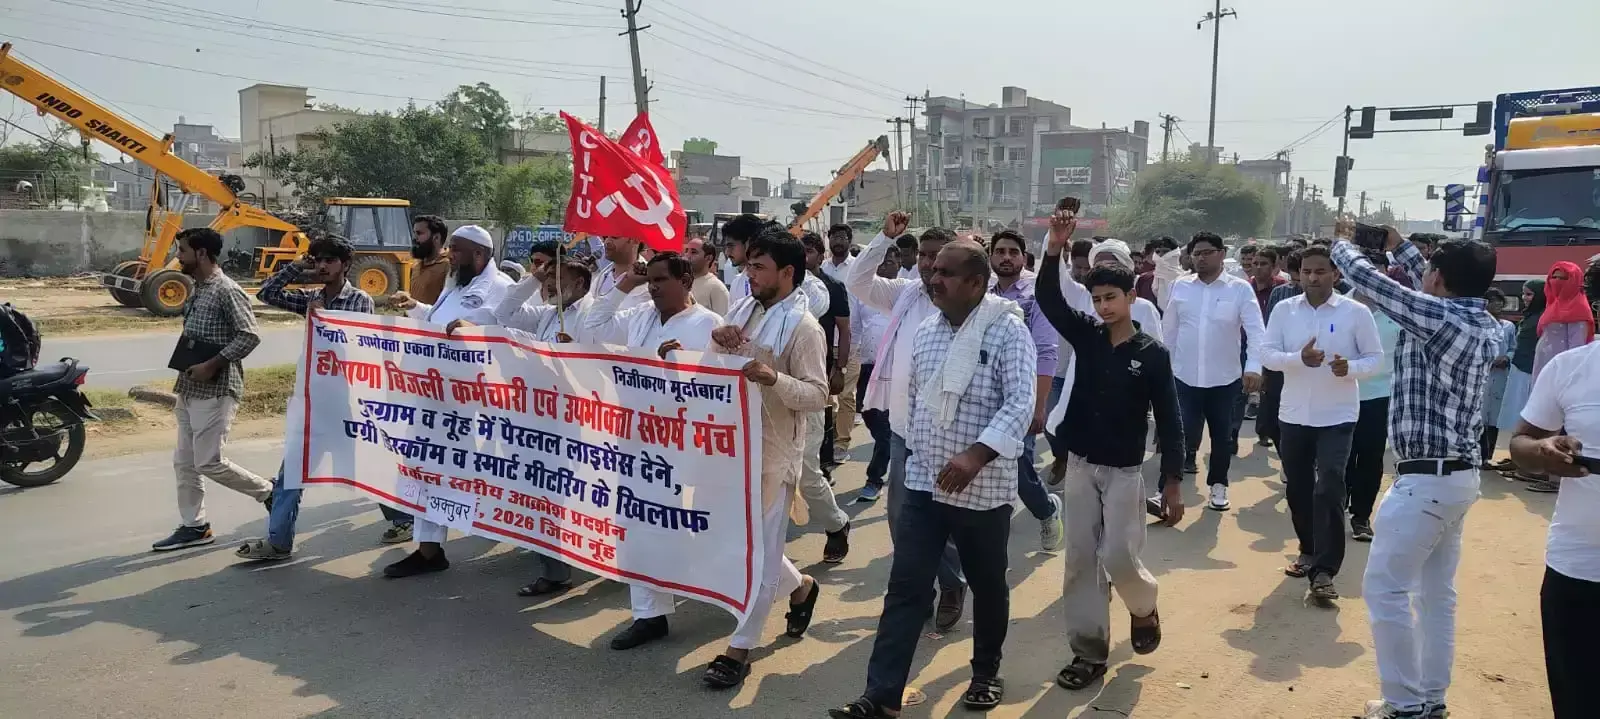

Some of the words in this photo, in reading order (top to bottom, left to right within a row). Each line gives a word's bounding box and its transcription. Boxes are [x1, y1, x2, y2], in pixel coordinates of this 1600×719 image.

[36, 92, 83, 119] INDO
[85, 119, 148, 154] SHAKTI
[576, 130, 599, 219] CITU
[356, 333, 400, 353] उपभोक्ता
[403, 341, 435, 359] एकता
[438, 342, 492, 365] जिंदाबाद!
[612, 366, 666, 395] निजीकरण
[384, 360, 445, 402] बिजली
[449, 372, 528, 414] कर्मचारी
[532, 385, 559, 420] एवं
[563, 390, 634, 440] उपभोक्ता
[692, 414, 737, 457] मंच
[343, 419, 378, 444] एग्री
[452, 447, 468, 469] व
[473, 454, 520, 481] स्मार्ट
[524, 460, 588, 502] मीटरिंग
[591, 479, 612, 509] के
[615, 485, 711, 534] खिलाफ
[421, 409, 437, 429] व
[442, 411, 473, 442] नूंह
[477, 413, 497, 440] में
[499, 417, 562, 456] पैरलल
[566, 438, 636, 477] लाइसेंस
[640, 450, 683, 496] देने,
[448, 476, 504, 500] स्तरीय
[508, 489, 567, 520] आक्रोश
[571, 508, 627, 542] प्रदर्शन
[493, 508, 535, 530] 2026
[540, 517, 583, 549] जिला
[588, 538, 617, 562] नूंह
